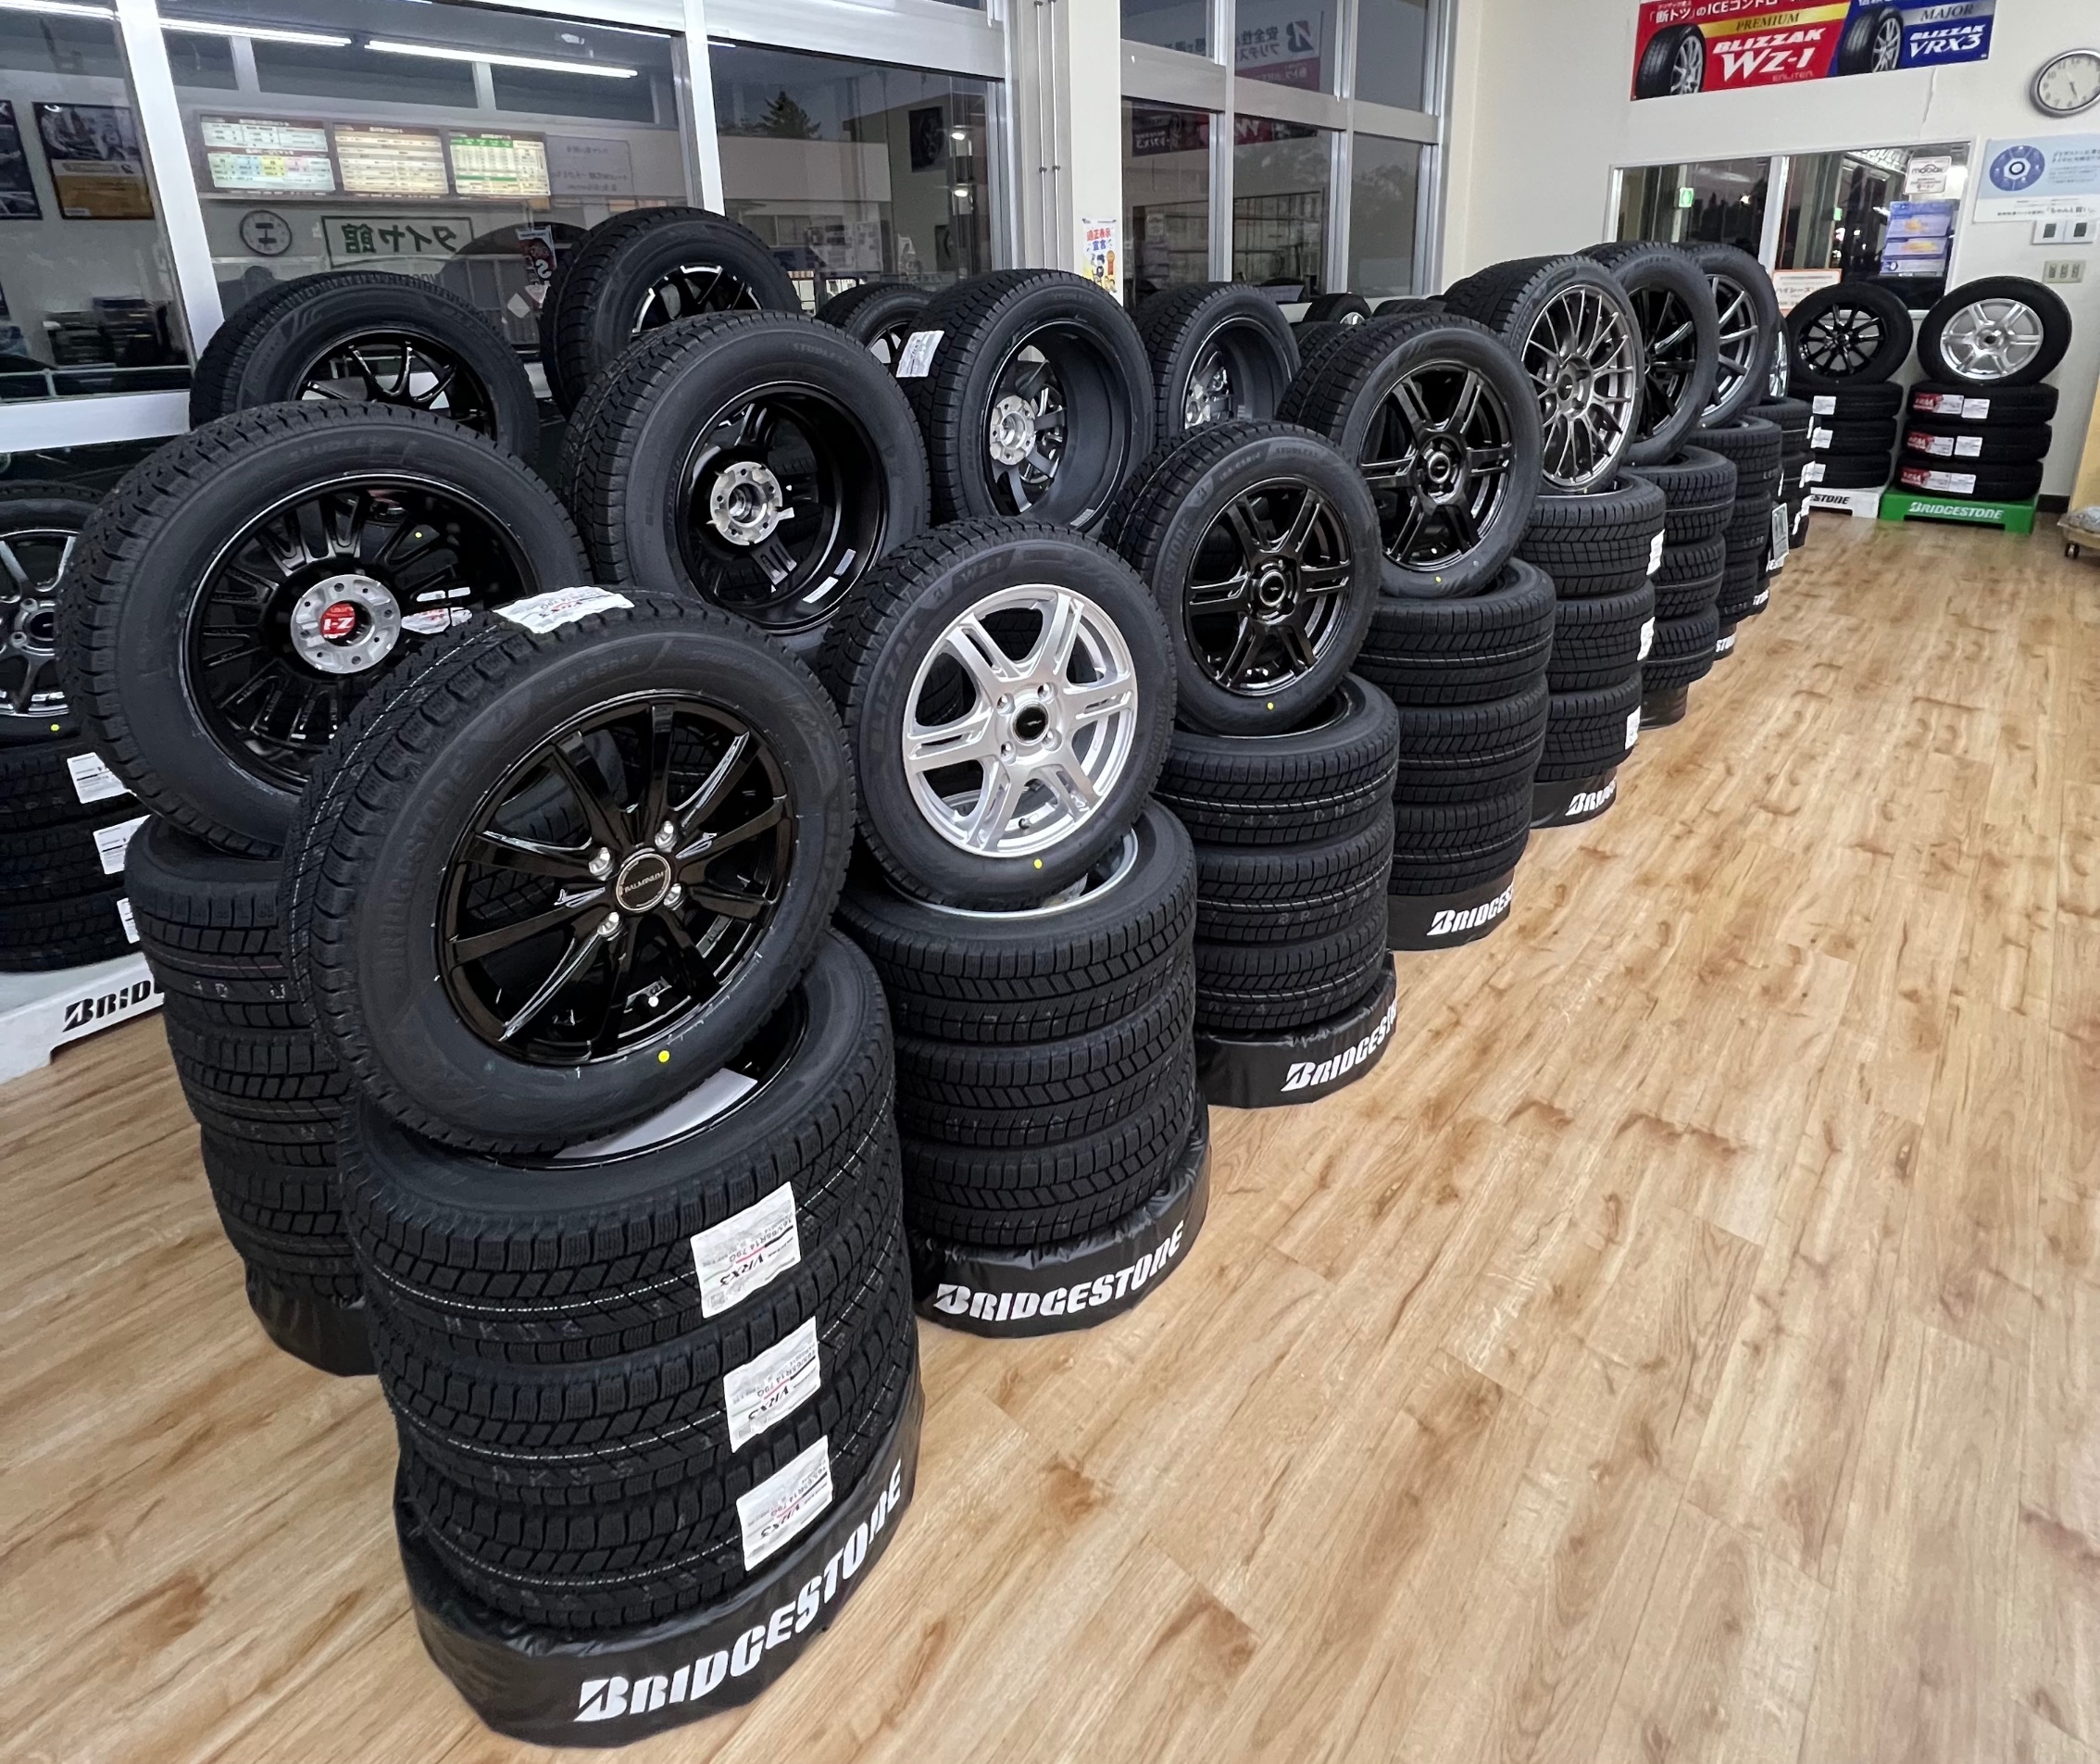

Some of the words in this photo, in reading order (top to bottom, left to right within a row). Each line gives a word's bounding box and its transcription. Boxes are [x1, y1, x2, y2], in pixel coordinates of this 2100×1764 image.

[1736, 13, 1800, 31] PREMIUM
[1920, 4, 1974, 22] MAJOR
[1713, 28, 1826, 54] BLIZZAK
[1909, 23, 1986, 41] BLIZZAK
[1910, 32, 1982, 58] VRX3
[1721, 47, 1816, 82] WZ-1
[1908, 501, 2004, 519] BRIDGESTONE
[62, 980, 152, 1032] BRID
[719, 1253, 764, 1287] VRX3
[932, 1220, 1184, 1321] BRIDGESTONE
[572, 1457, 902, 1722] BRIDGESTONE
